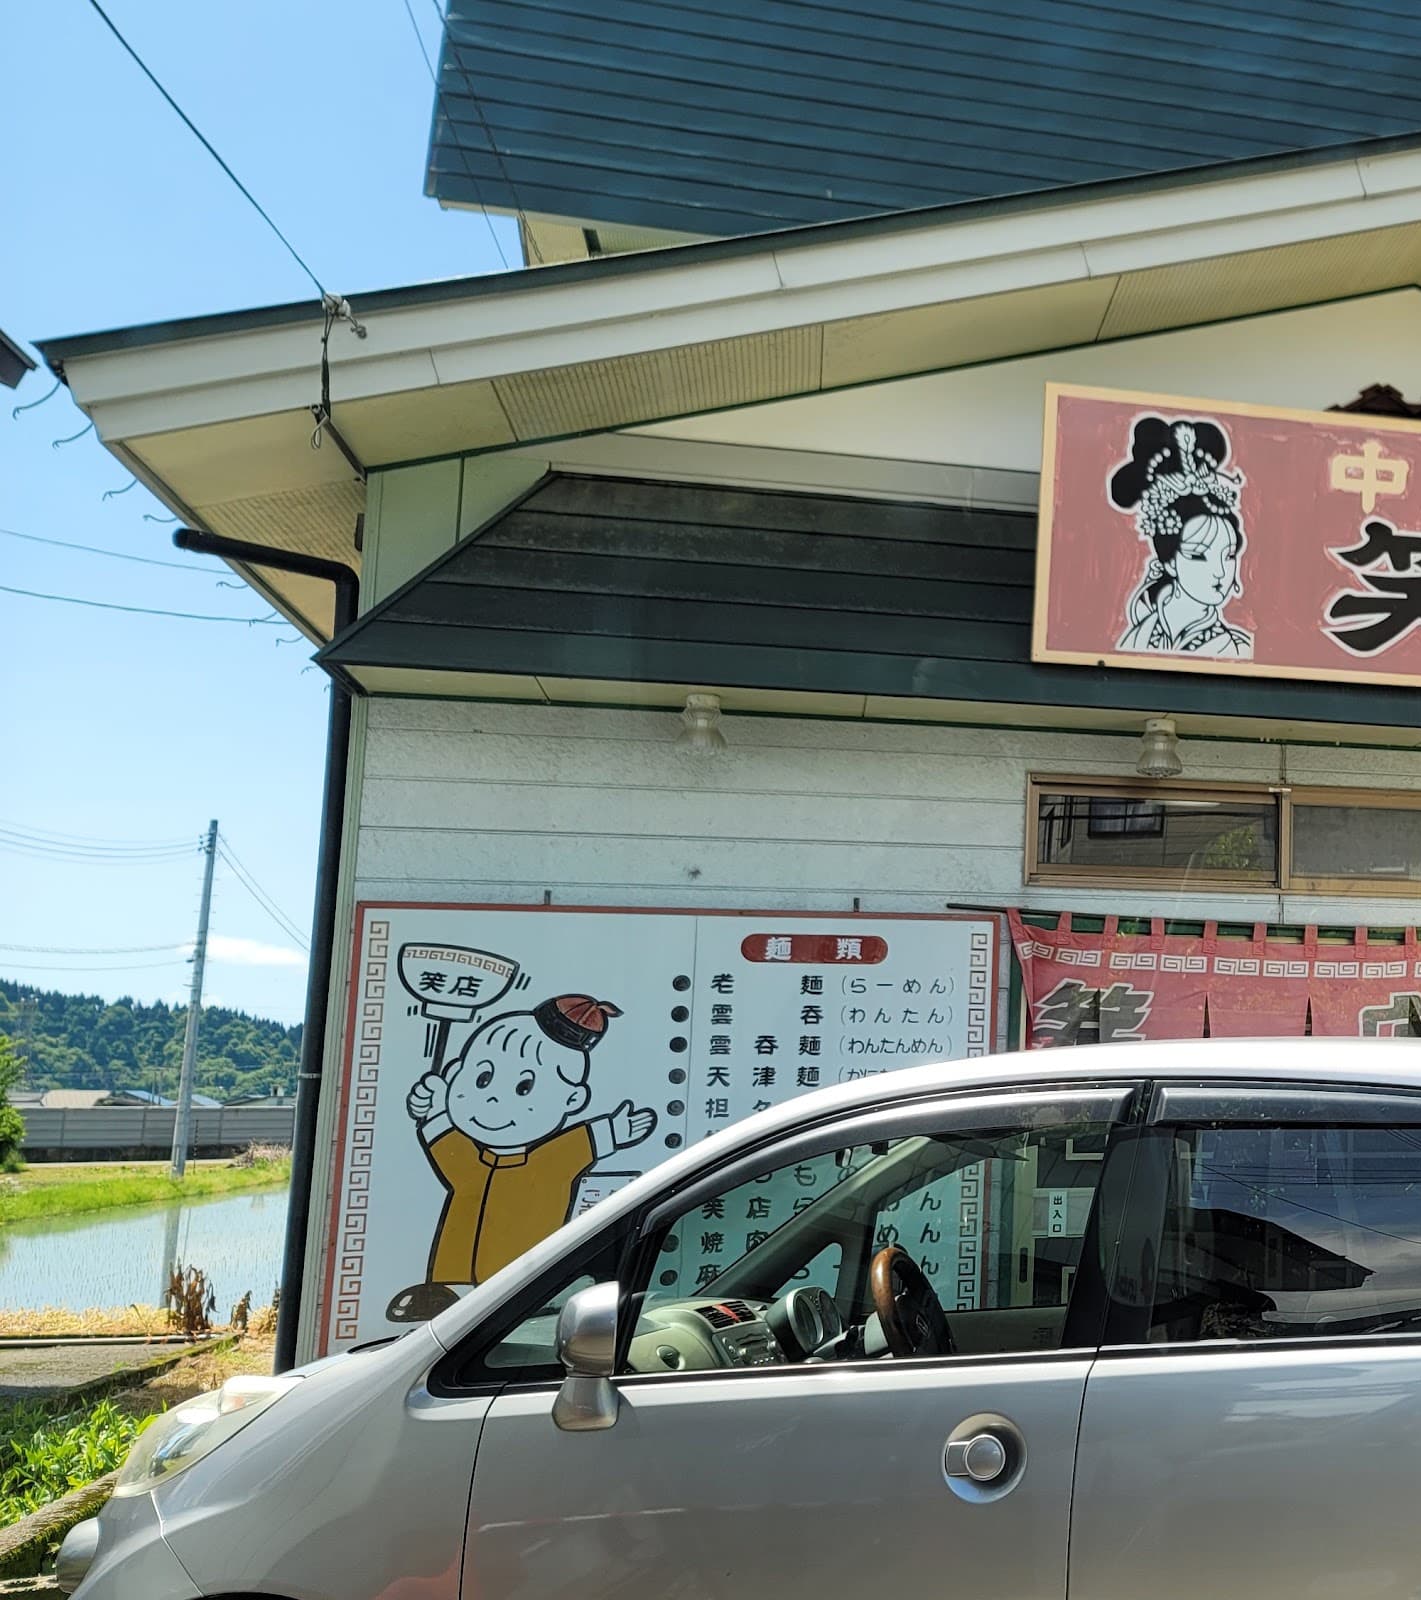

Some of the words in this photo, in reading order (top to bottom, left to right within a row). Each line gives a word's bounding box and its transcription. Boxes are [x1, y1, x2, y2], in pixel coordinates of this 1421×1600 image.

[764, 936, 862, 961] 麺類
[419, 971, 484, 998] 笑店
[1052, 1195, 1063, 1233] 出入口
